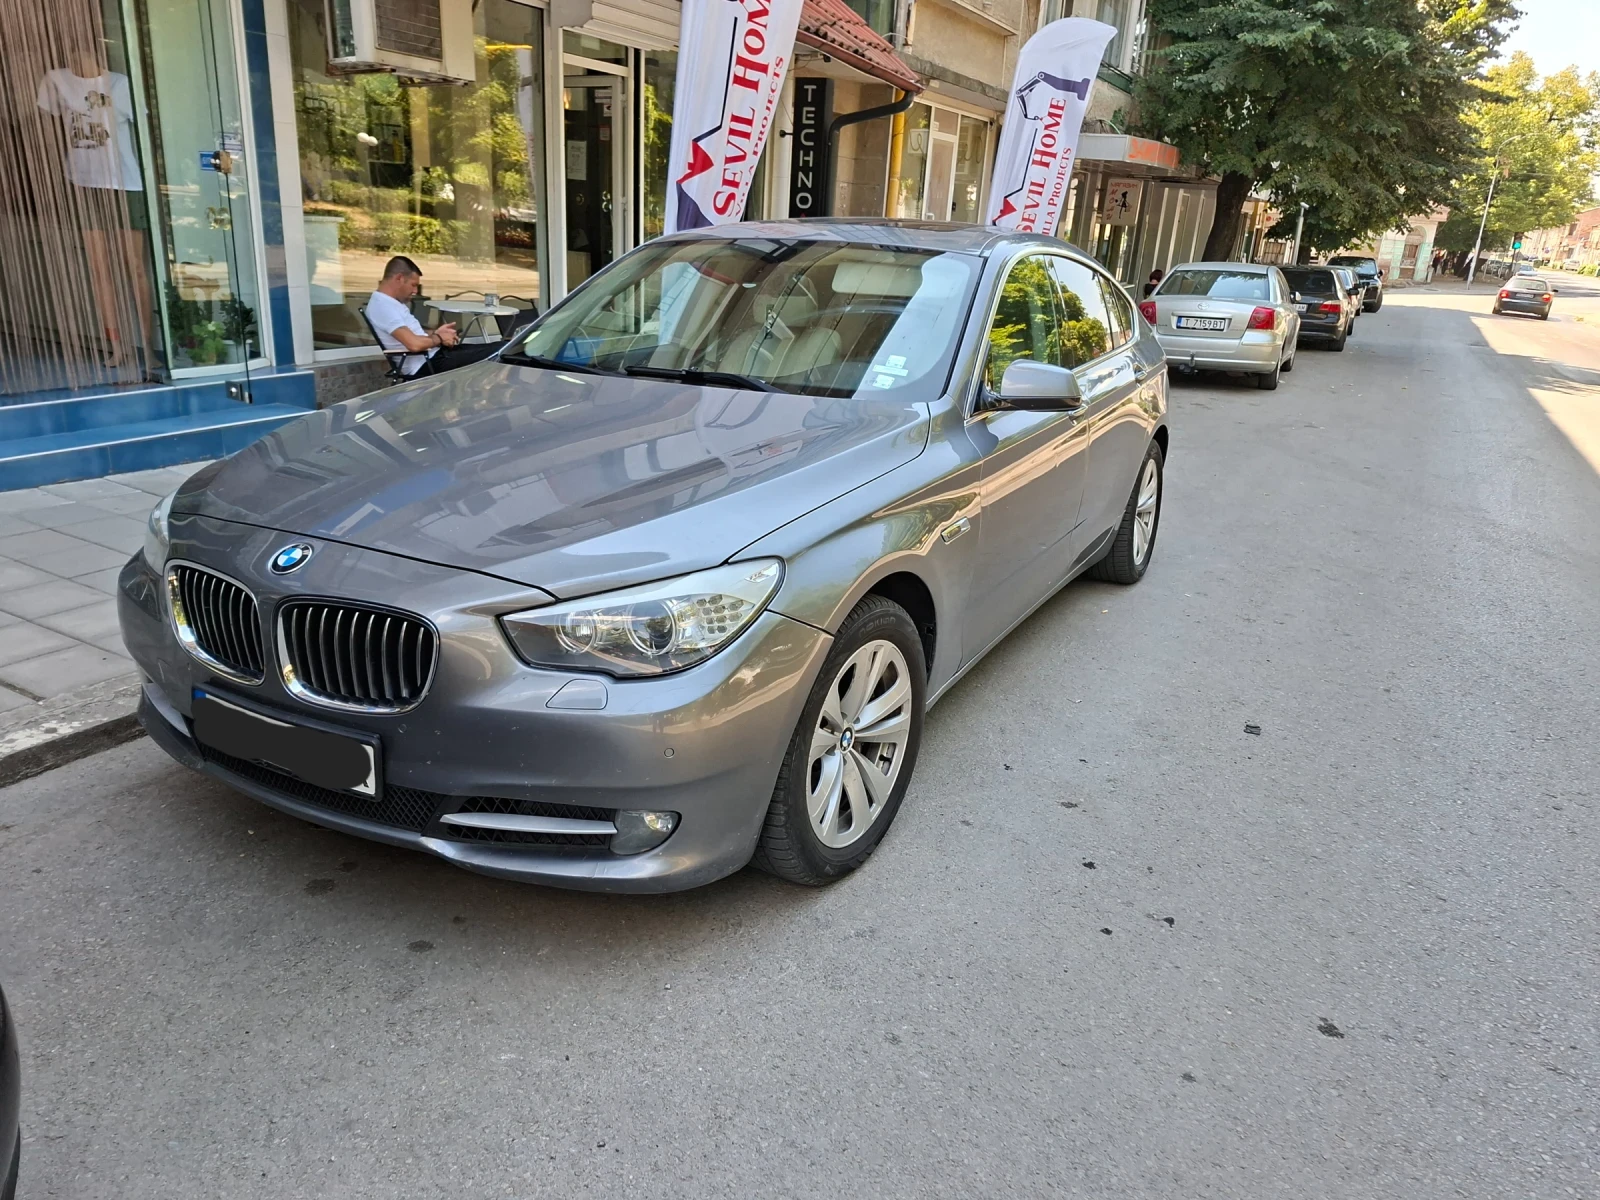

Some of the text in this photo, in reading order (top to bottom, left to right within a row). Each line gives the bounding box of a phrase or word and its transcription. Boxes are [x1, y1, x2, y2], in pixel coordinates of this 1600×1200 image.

[752, 56, 784, 157] PROJECTS
[796, 84, 817, 209] TECHNO
[1031, 97, 1067, 170] HOME
[713, 106, 756, 218] SEVIL
[1042, 147, 1072, 236] ILLA PROJECTS
